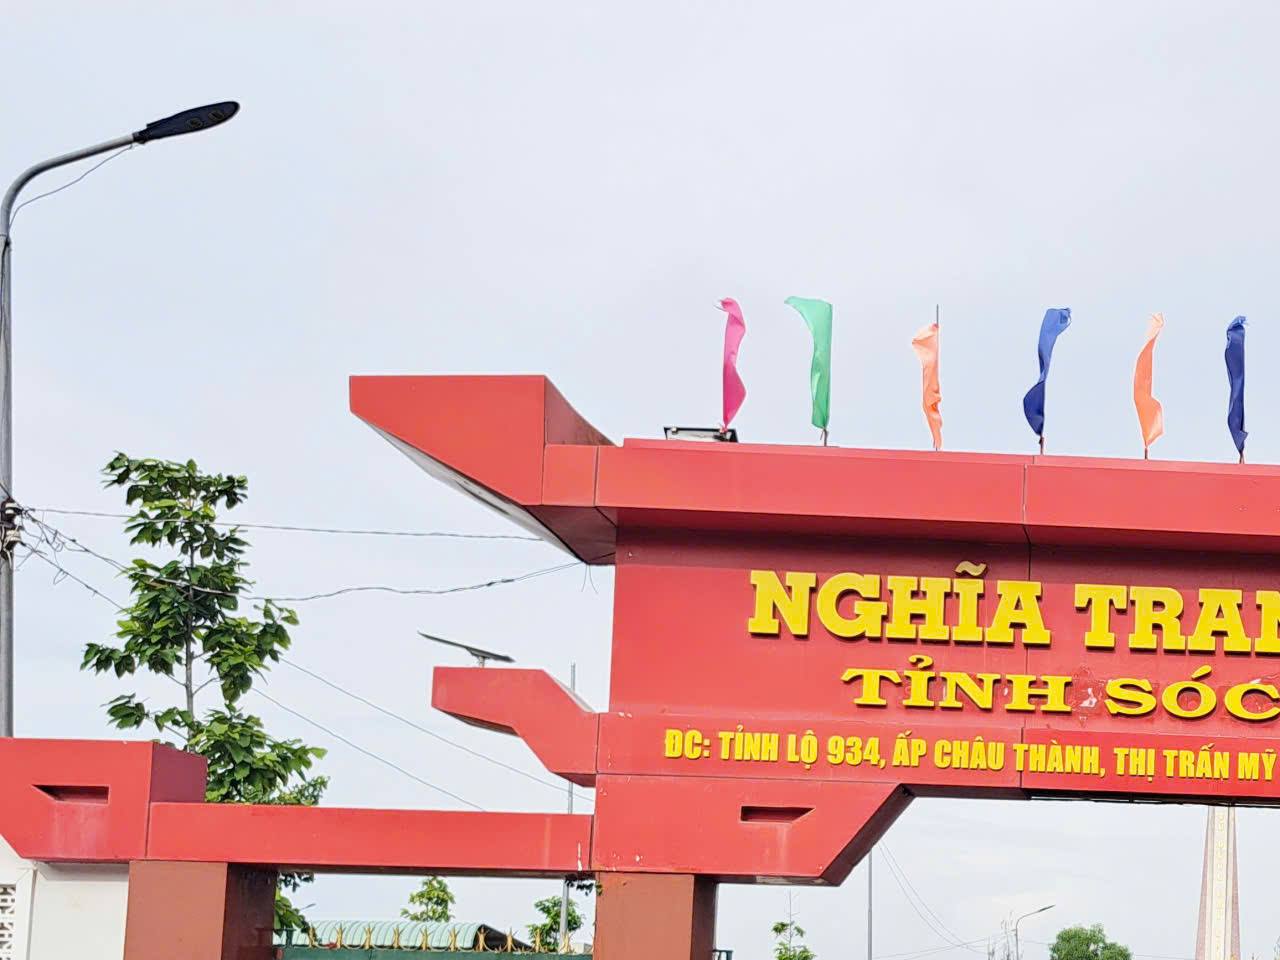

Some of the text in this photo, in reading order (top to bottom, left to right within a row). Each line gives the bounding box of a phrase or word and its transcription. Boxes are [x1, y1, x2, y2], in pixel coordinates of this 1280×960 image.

[748, 560, 1051, 646] NGHĨA
[841, 654, 1073, 713] TỈNH
[1104, 665, 1280, 721] SÓC
[664, 727, 712, 760] ĐC:
[719, 724, 780, 762] TỈNH
[787, 729, 819, 770] LỘ
[827, 735, 886, 769] 934,
[892, 729, 928, 768] ẤP
[934, 736, 1006, 771] CHÂU
[1013, 740, 1106, 778] THÀNH,
[1114, 747, 1156, 782] THỊ
[1163, 743, 1231, 780] TRẤN
[1238, 749, 1277, 782] MỸ
